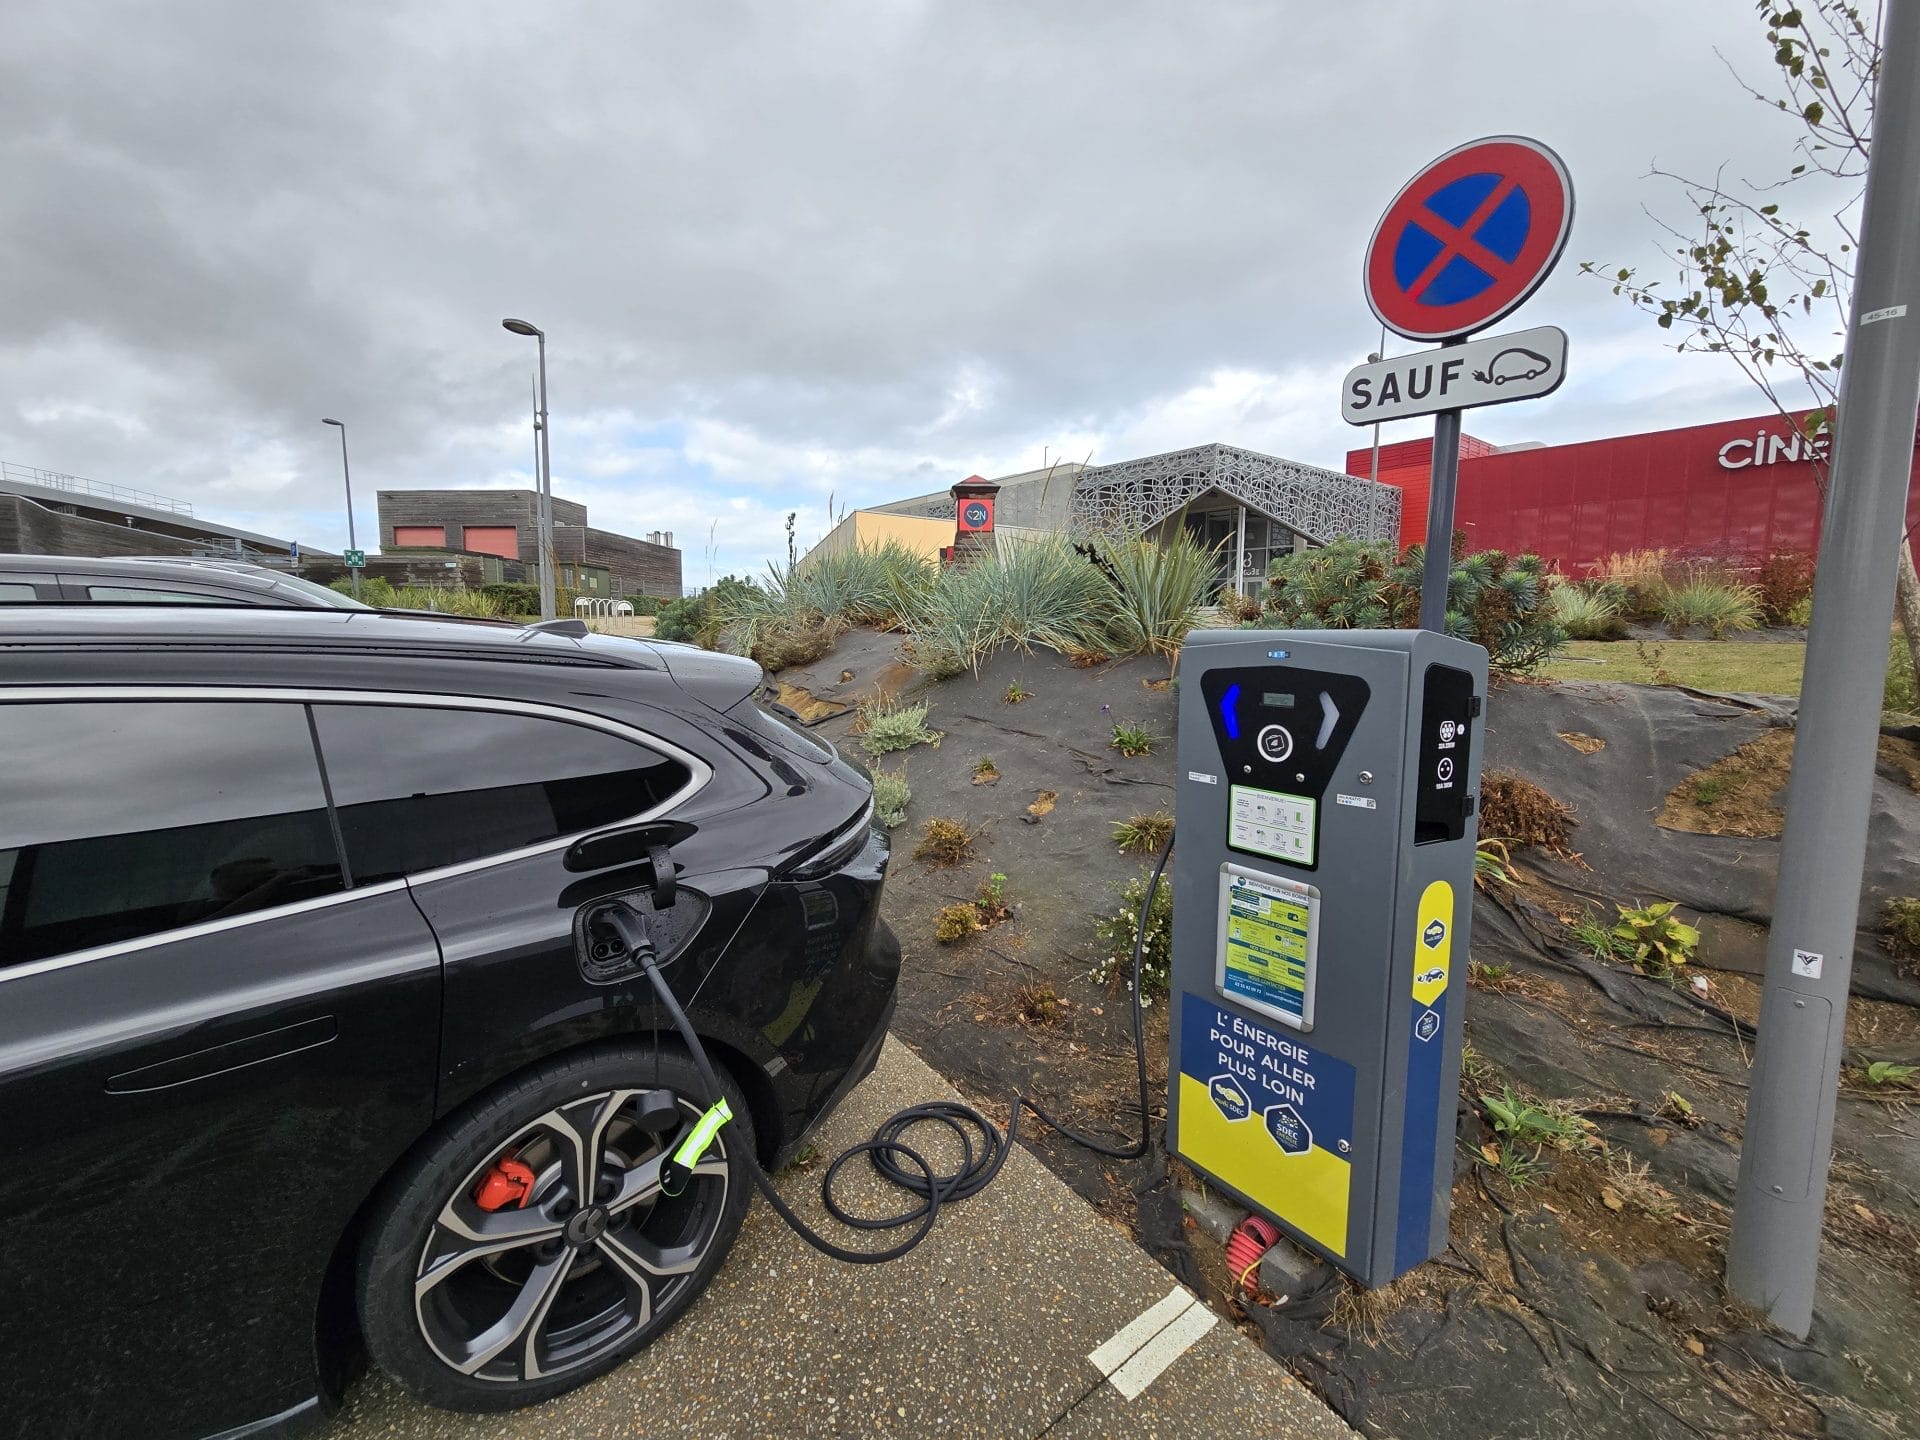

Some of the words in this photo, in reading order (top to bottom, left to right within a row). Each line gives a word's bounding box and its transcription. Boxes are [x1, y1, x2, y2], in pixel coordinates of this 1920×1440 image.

[1350, 358, 1465, 410] SAUF
[1210, 1028, 1255, 1061] POUR
[1261, 1054, 1316, 1090] ALLER
[1233, 1017, 1309, 1065] ÉNERGIE
[1218, 1052, 1257, 1081] PLUS
[1262, 1074, 1304, 1106] LOIN
[1276, 1123, 1298, 1141] SDEC
